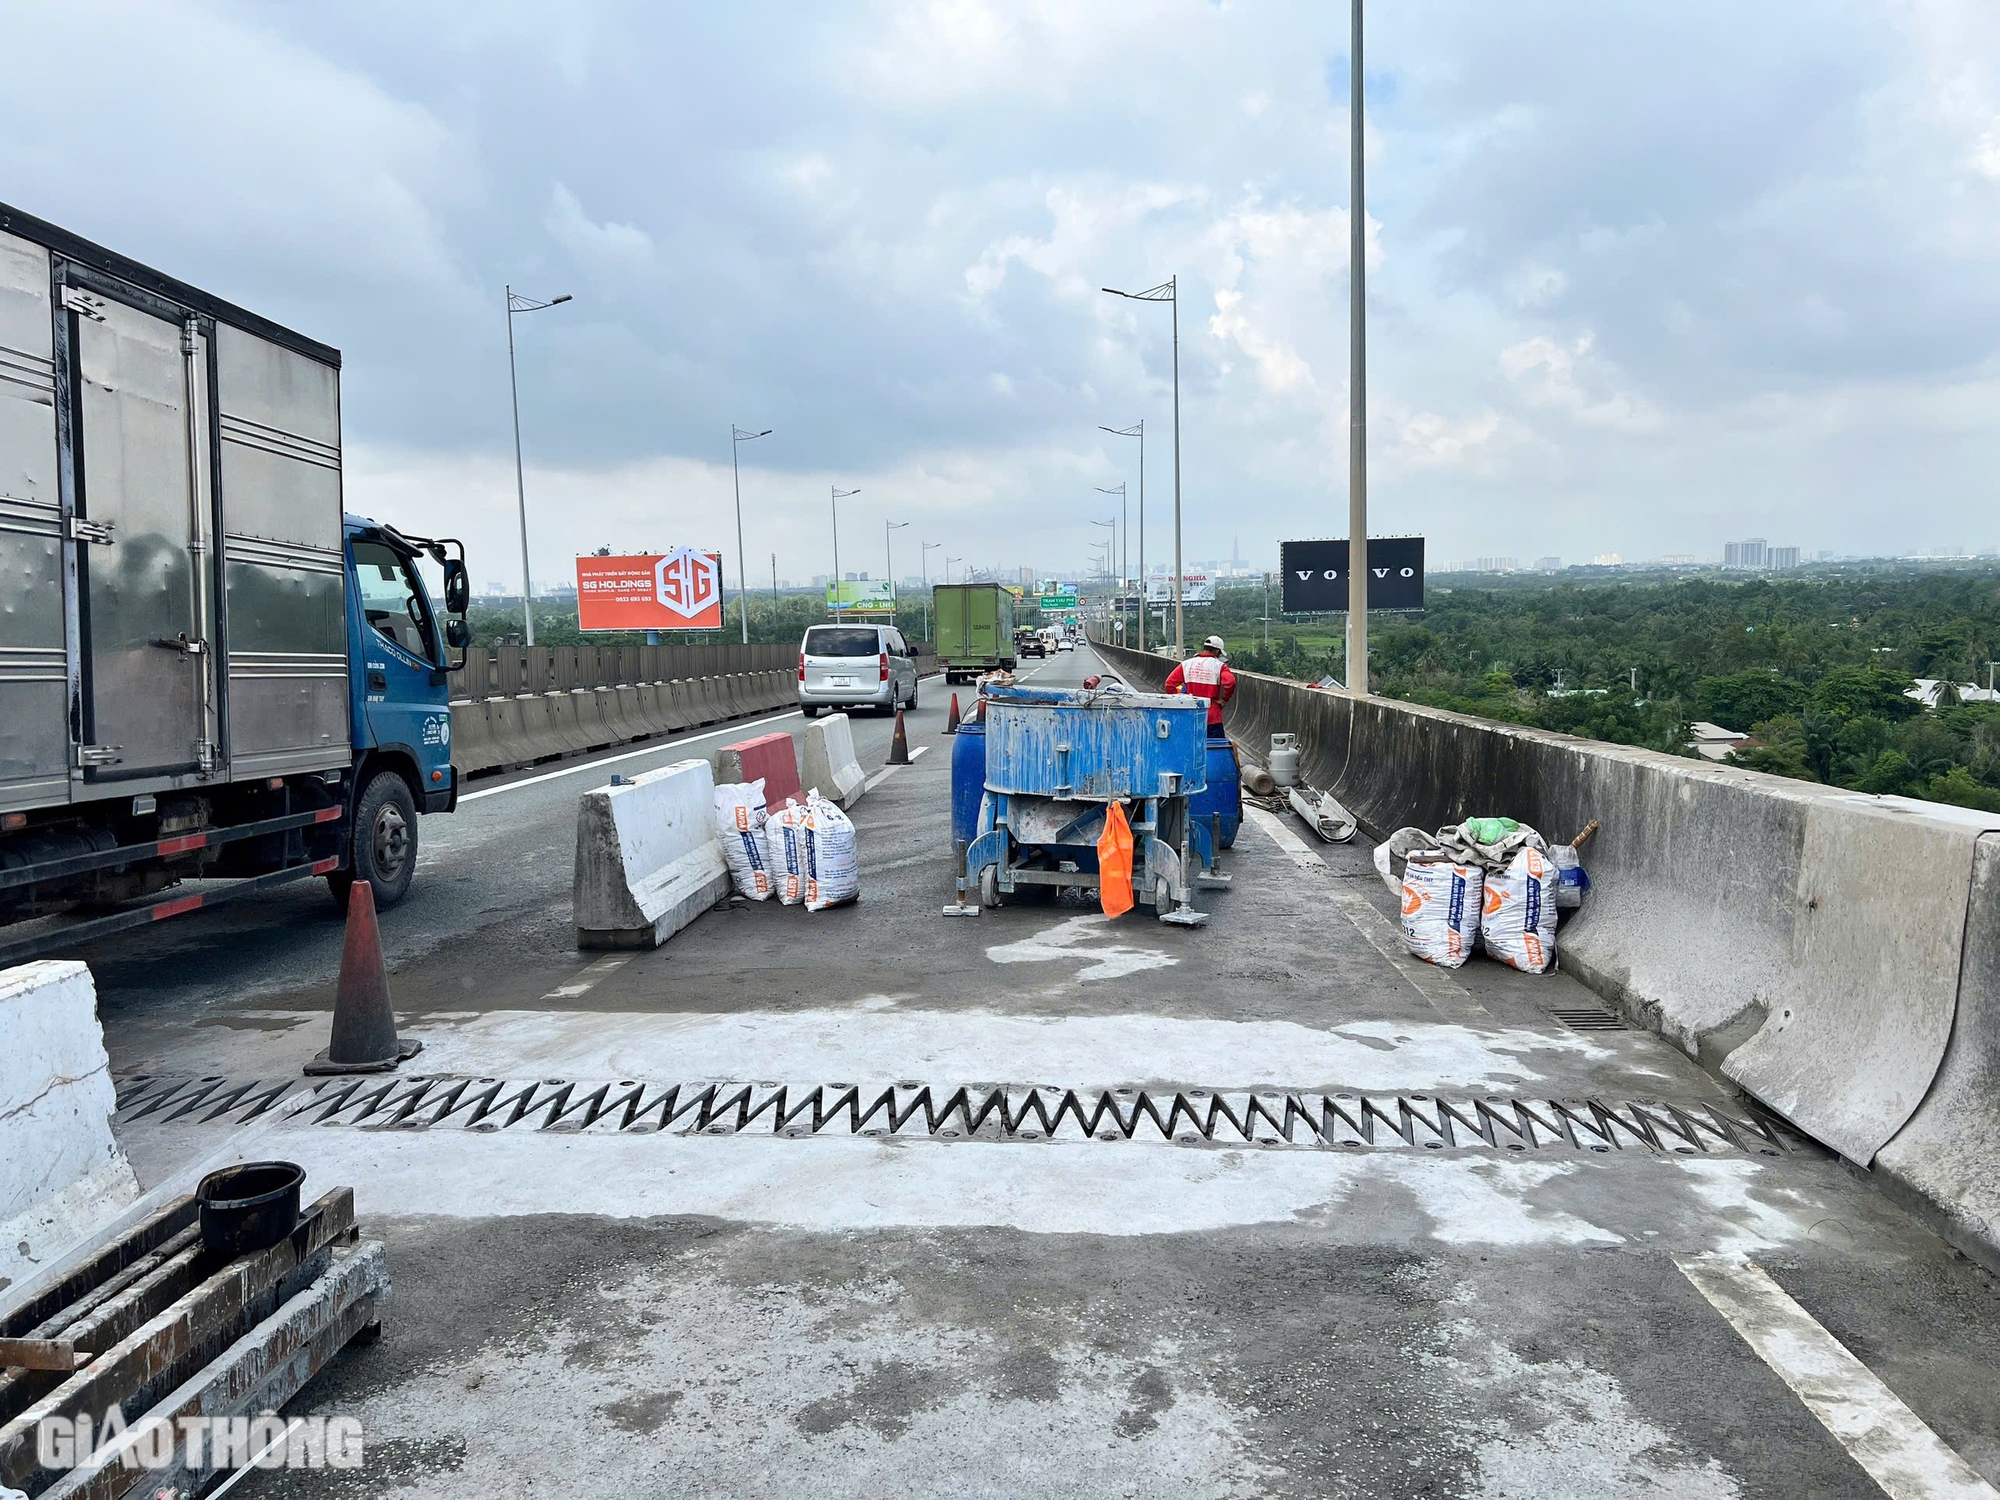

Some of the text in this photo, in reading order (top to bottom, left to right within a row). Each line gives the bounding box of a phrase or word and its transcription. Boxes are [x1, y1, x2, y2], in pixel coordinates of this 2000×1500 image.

[1296, 567, 1414, 581] VOVO
[582, 580, 652, 589] SG HOLDINGS
